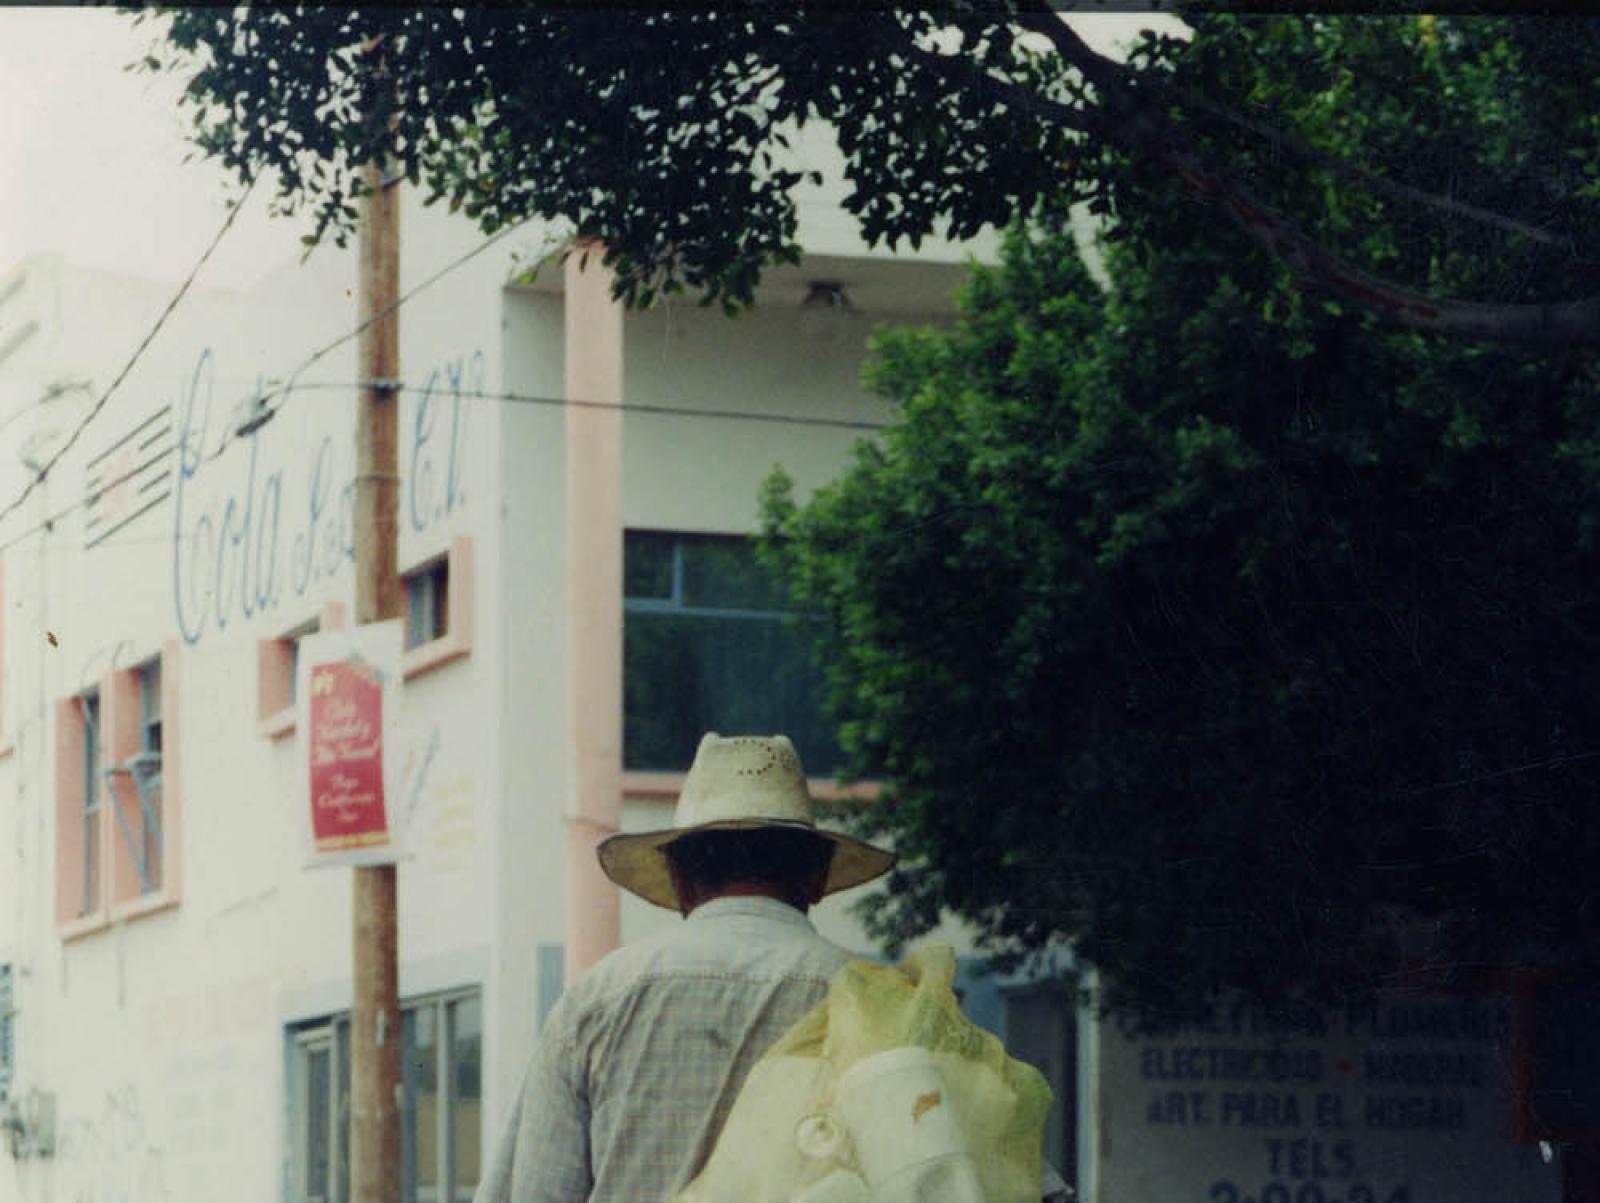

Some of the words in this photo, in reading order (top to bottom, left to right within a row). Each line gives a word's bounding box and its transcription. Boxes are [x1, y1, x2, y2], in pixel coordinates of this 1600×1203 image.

[1219, 1091, 1303, 1128] PARA
[1315, 1092, 1347, 1131] EL
[1364, 1094, 1469, 1132] HOGAR
[1264, 1138, 1356, 1179] TELS
